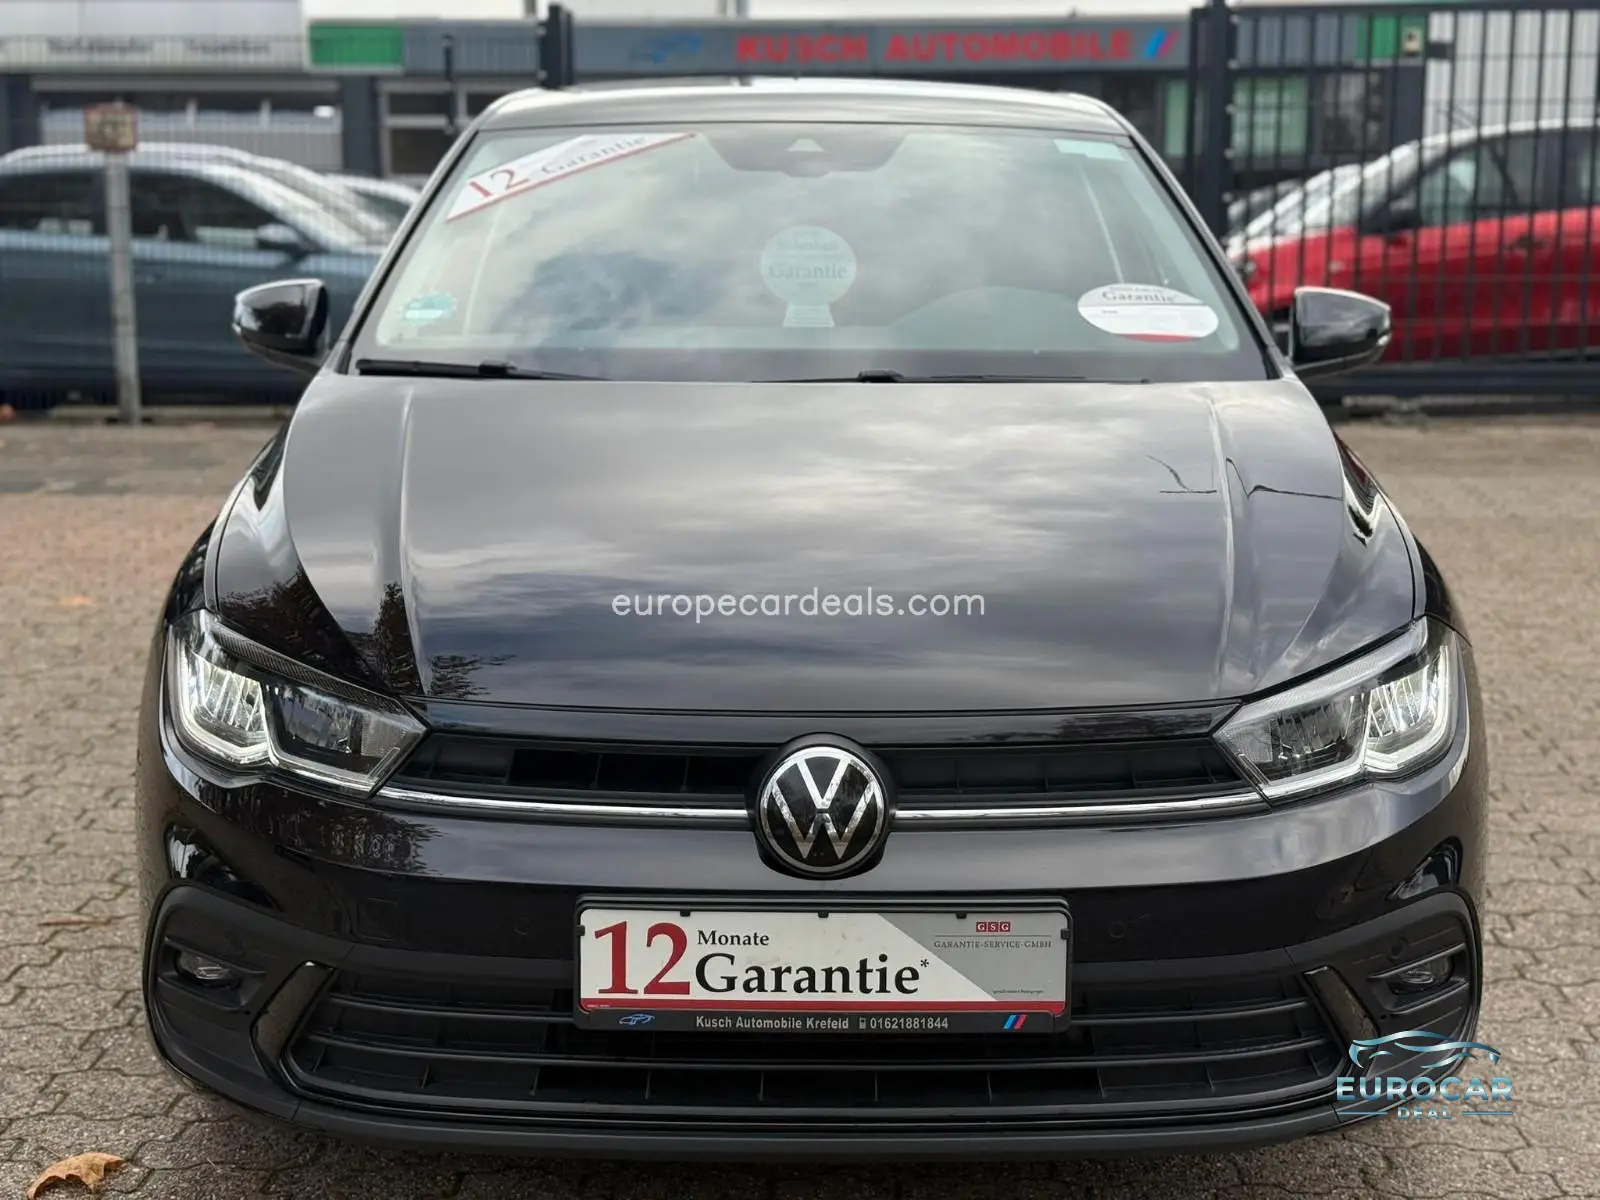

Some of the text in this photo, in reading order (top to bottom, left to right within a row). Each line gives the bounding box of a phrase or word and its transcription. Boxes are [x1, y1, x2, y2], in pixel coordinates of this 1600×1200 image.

[736, 30, 1133, 63] KUSCH AUTOMOBILE
[468, 168, 530, 197] 12
[976, 921, 1011, 932] GSG
[594, 920, 770, 996] 12 Monate
[696, 1016, 949, 1030] Kusch Automobile Krefeld 01621881844
